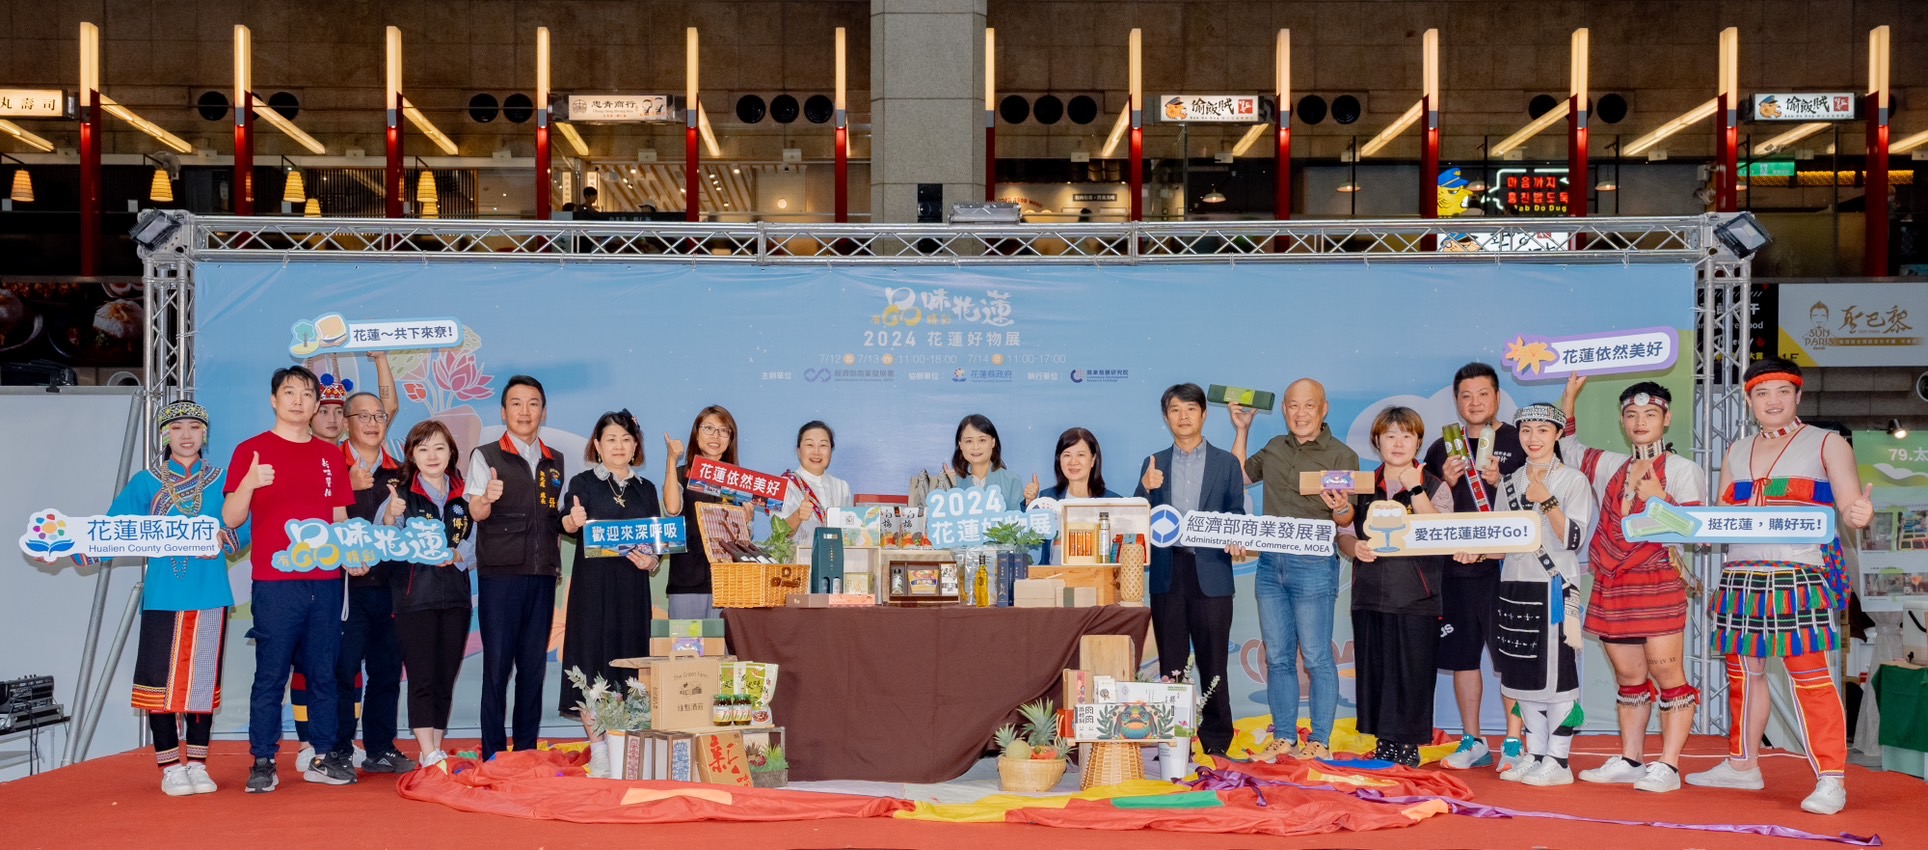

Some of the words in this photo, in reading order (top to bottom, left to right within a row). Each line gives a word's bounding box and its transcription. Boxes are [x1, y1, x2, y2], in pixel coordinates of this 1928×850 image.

[1534, 204, 1546, 212] Do
[1548, 204, 1567, 212] Dug
[864, 331, 916, 346] 2024
[927, 331, 1021, 346] 花蓮好物展
[1808, 329, 1830, 338] SUN
[1804, 338, 1834, 346] PARIS
[1562, 341, 1663, 364] 花蓮依然美好
[970, 369, 1012, 379] 花蓮縣政府
[699, 463, 781, 496] 花蓮依然美好
[930, 489, 1002, 518] 2024
[87, 519, 215, 541] 花蓮縣政府
[591, 523, 678, 542] 歡迎來深呼吸
[1186, 515, 1332, 542] 經濟部商業發展署
[88, 545, 125, 553] Hualien
[127, 544, 161, 554] County
[164, 544, 215, 552] Goverment
[1244, 539, 1253, 547] of
[1255, 541, 1301, 551] Commerce,
[1304, 544, 1331, 553] MOEA
